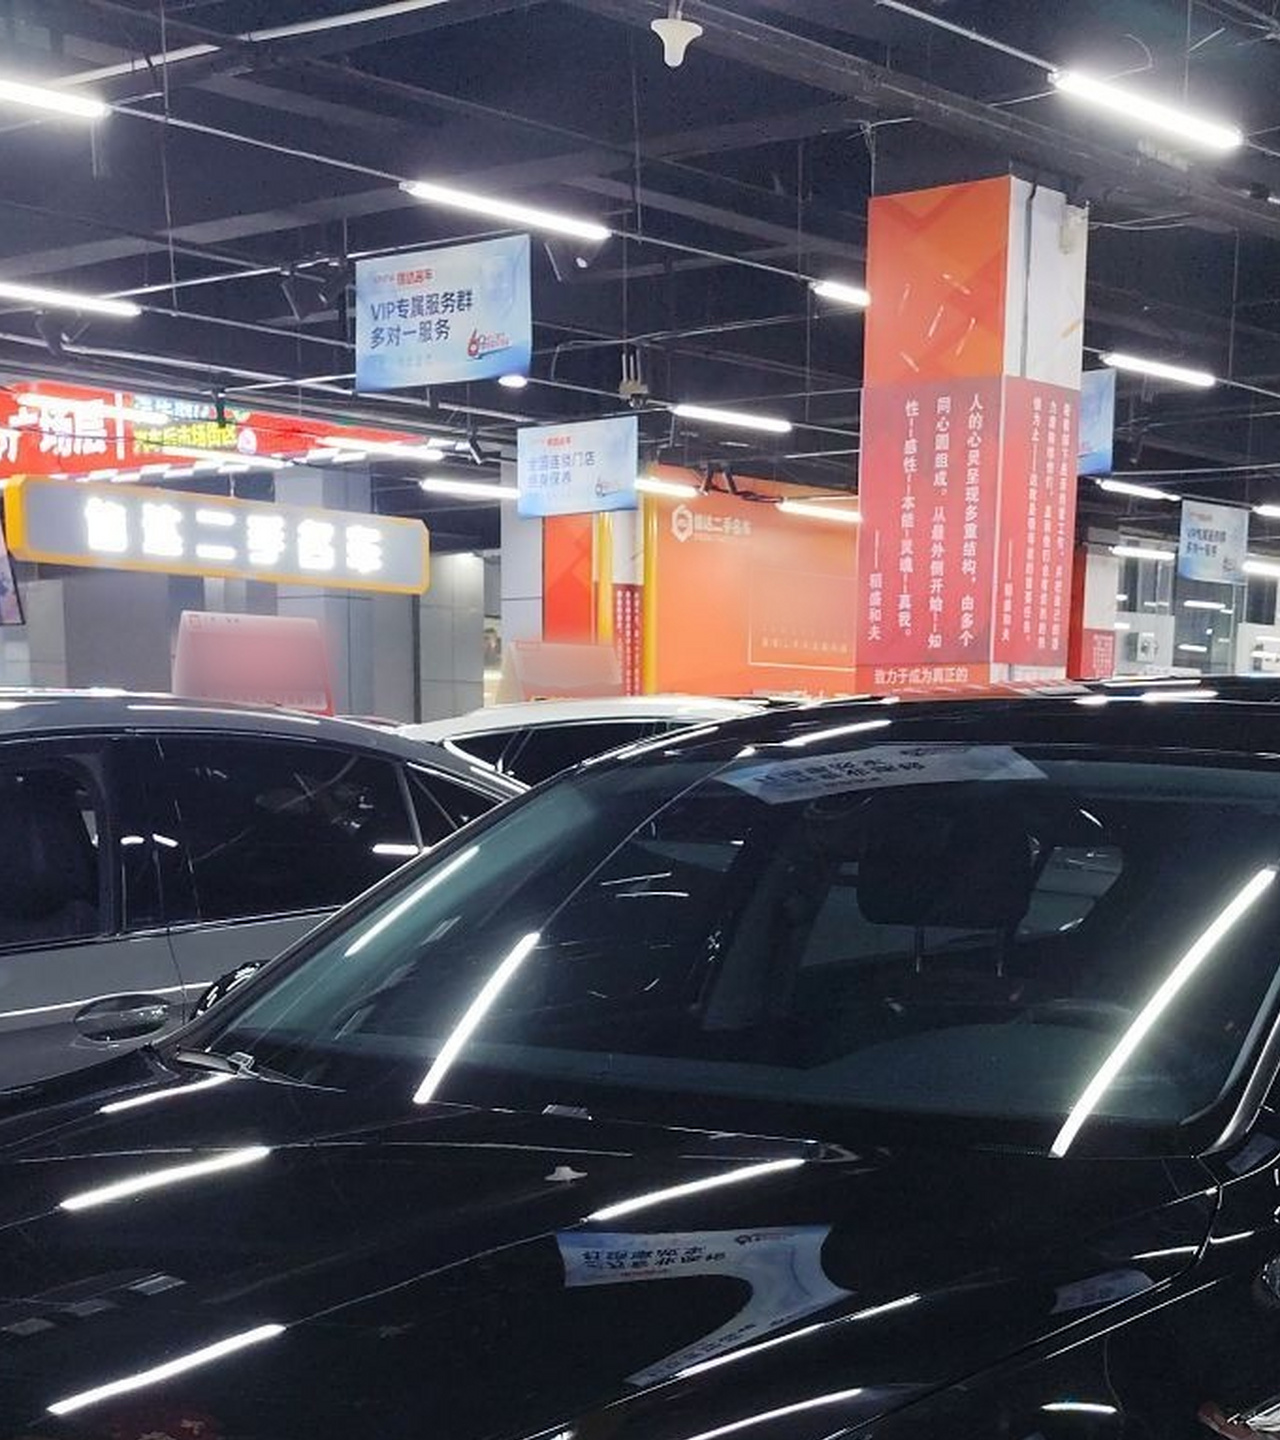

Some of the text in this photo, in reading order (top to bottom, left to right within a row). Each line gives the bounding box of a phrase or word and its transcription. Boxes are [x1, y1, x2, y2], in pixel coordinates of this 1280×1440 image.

[370, 290, 473, 322] VIP专属服务群
[370, 318, 451, 350] 多对一服务
